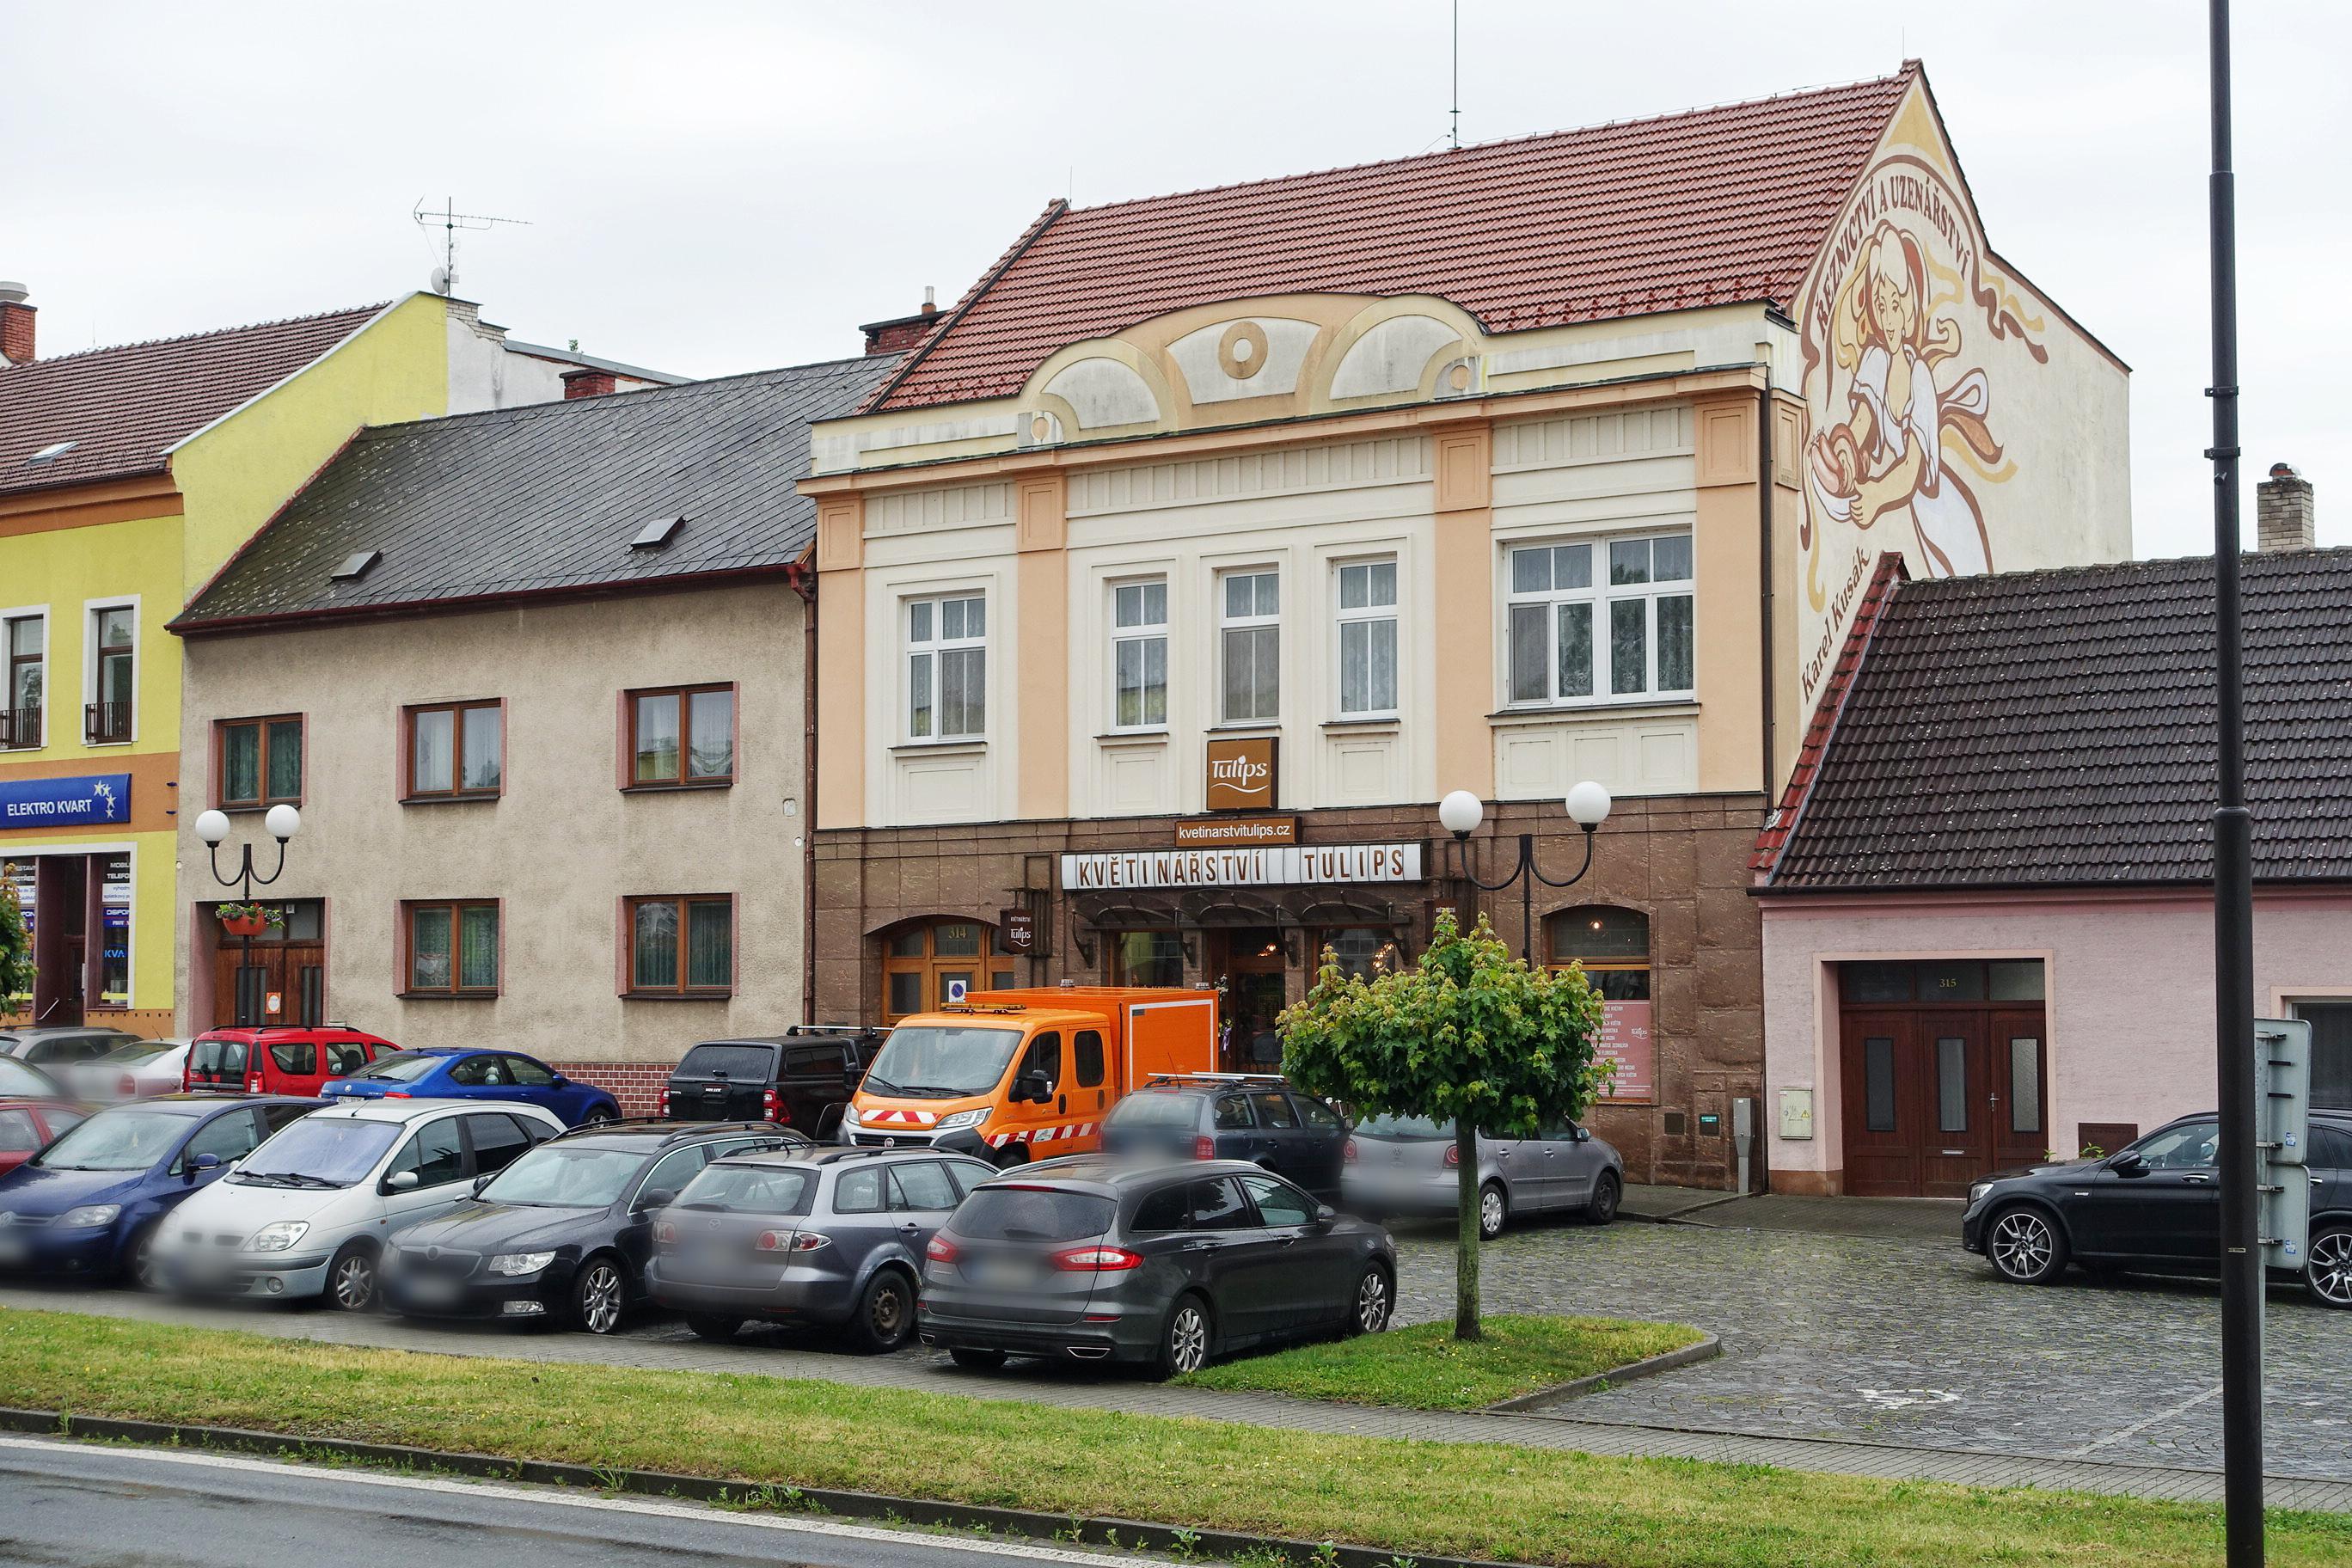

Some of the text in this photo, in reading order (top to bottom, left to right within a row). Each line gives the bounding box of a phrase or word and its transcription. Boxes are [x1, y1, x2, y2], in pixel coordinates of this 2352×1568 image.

[1815, 175, 1970, 341] ŘEZNICTVÍ A UZENÁŘSTVÍ
[1801, 546, 1871, 704] Karel Kusák
[1211, 755, 1267, 786] Tulips
[7, 799, 92, 817] ELEKTRO KVART
[1179, 823, 1290, 840] kvetinarstvitulips.cz
[1079, 849, 1404, 886] KVĚTINÁŘSTVÍ TULIPS
[948, 926, 966, 939] 314
[1010, 927, 1032, 943] Tulips
[1939, 978, 1957, 988] 315
